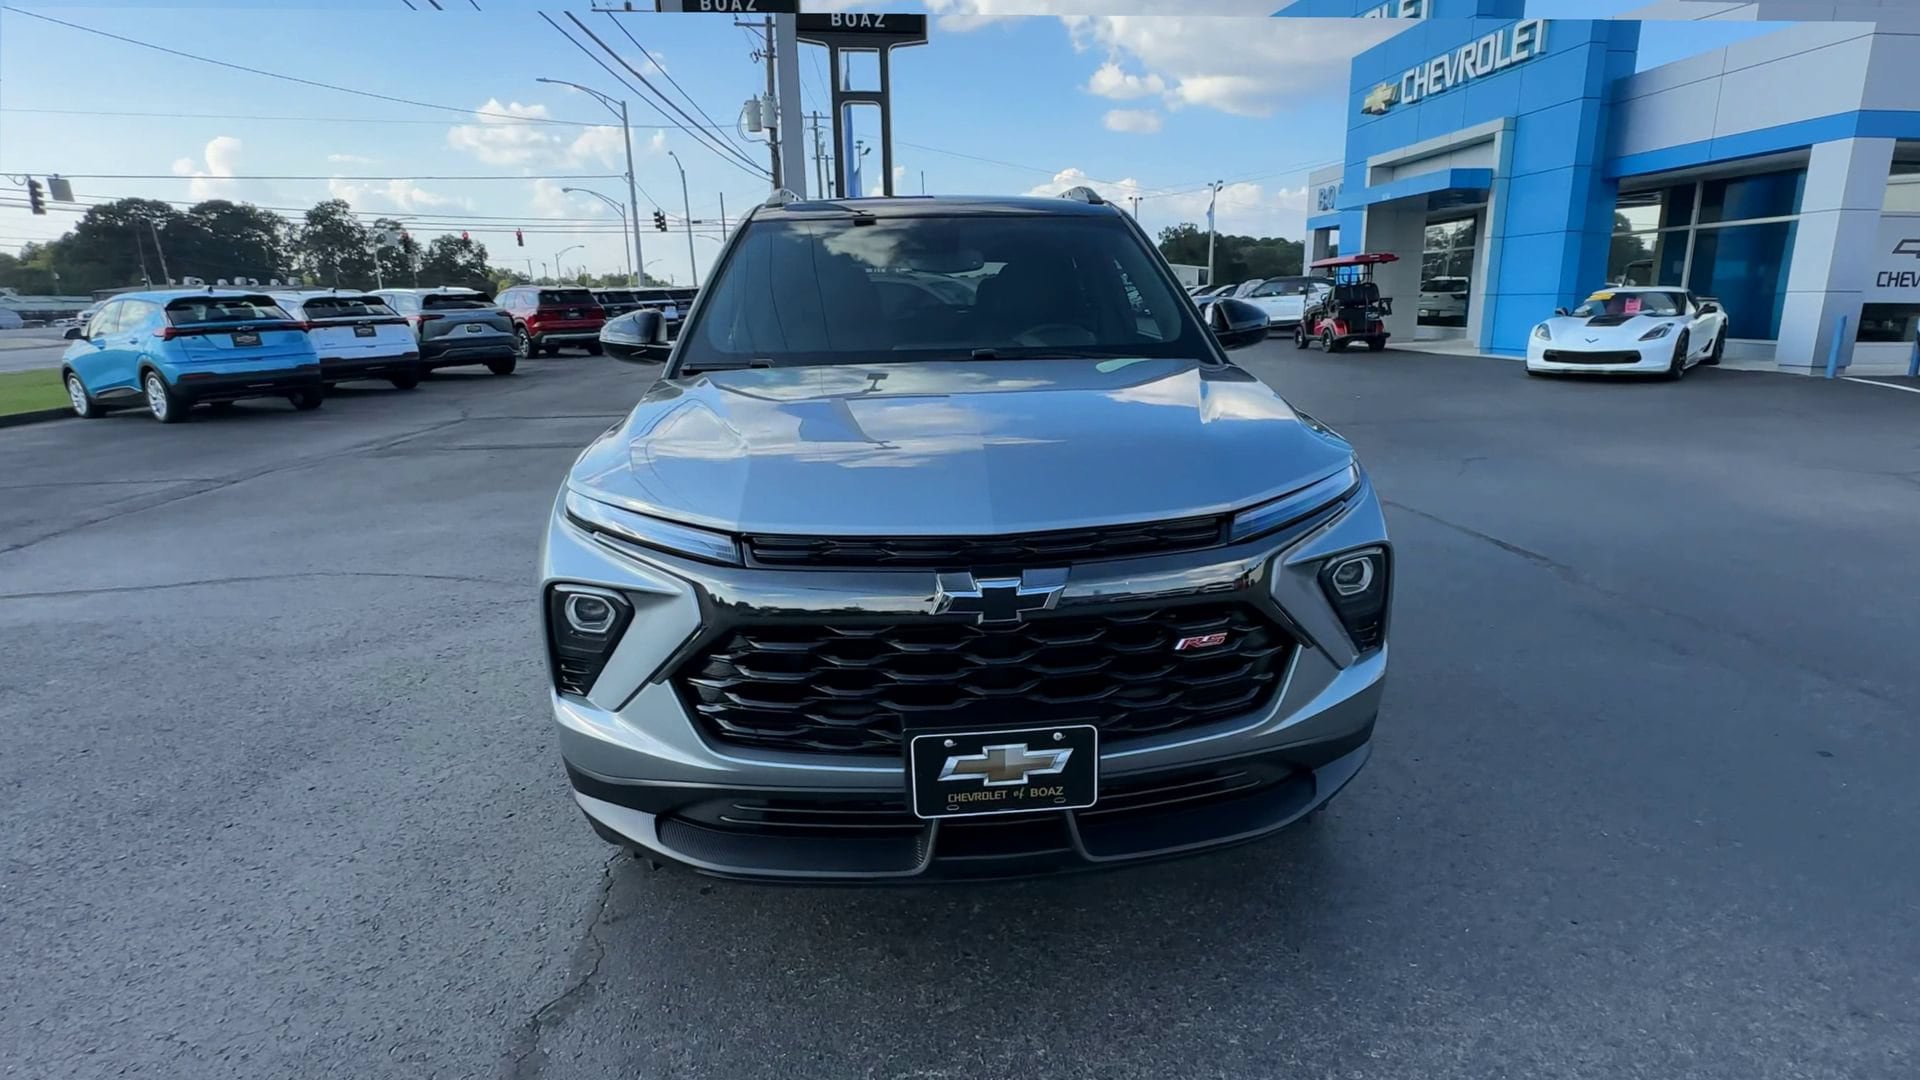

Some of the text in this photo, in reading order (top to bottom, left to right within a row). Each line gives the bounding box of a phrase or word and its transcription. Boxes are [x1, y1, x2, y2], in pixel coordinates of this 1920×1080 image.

[831, 13, 885, 28] BOAZ
[1401, 19, 1545, 104] CHEVROLET
[1317, 184, 1343, 211] BO
[1876, 271, 1920, 288] CHEV
[1175, 633, 1228, 650] RS
[948, 786, 1064, 803] CHEVROLET of BOAZ
